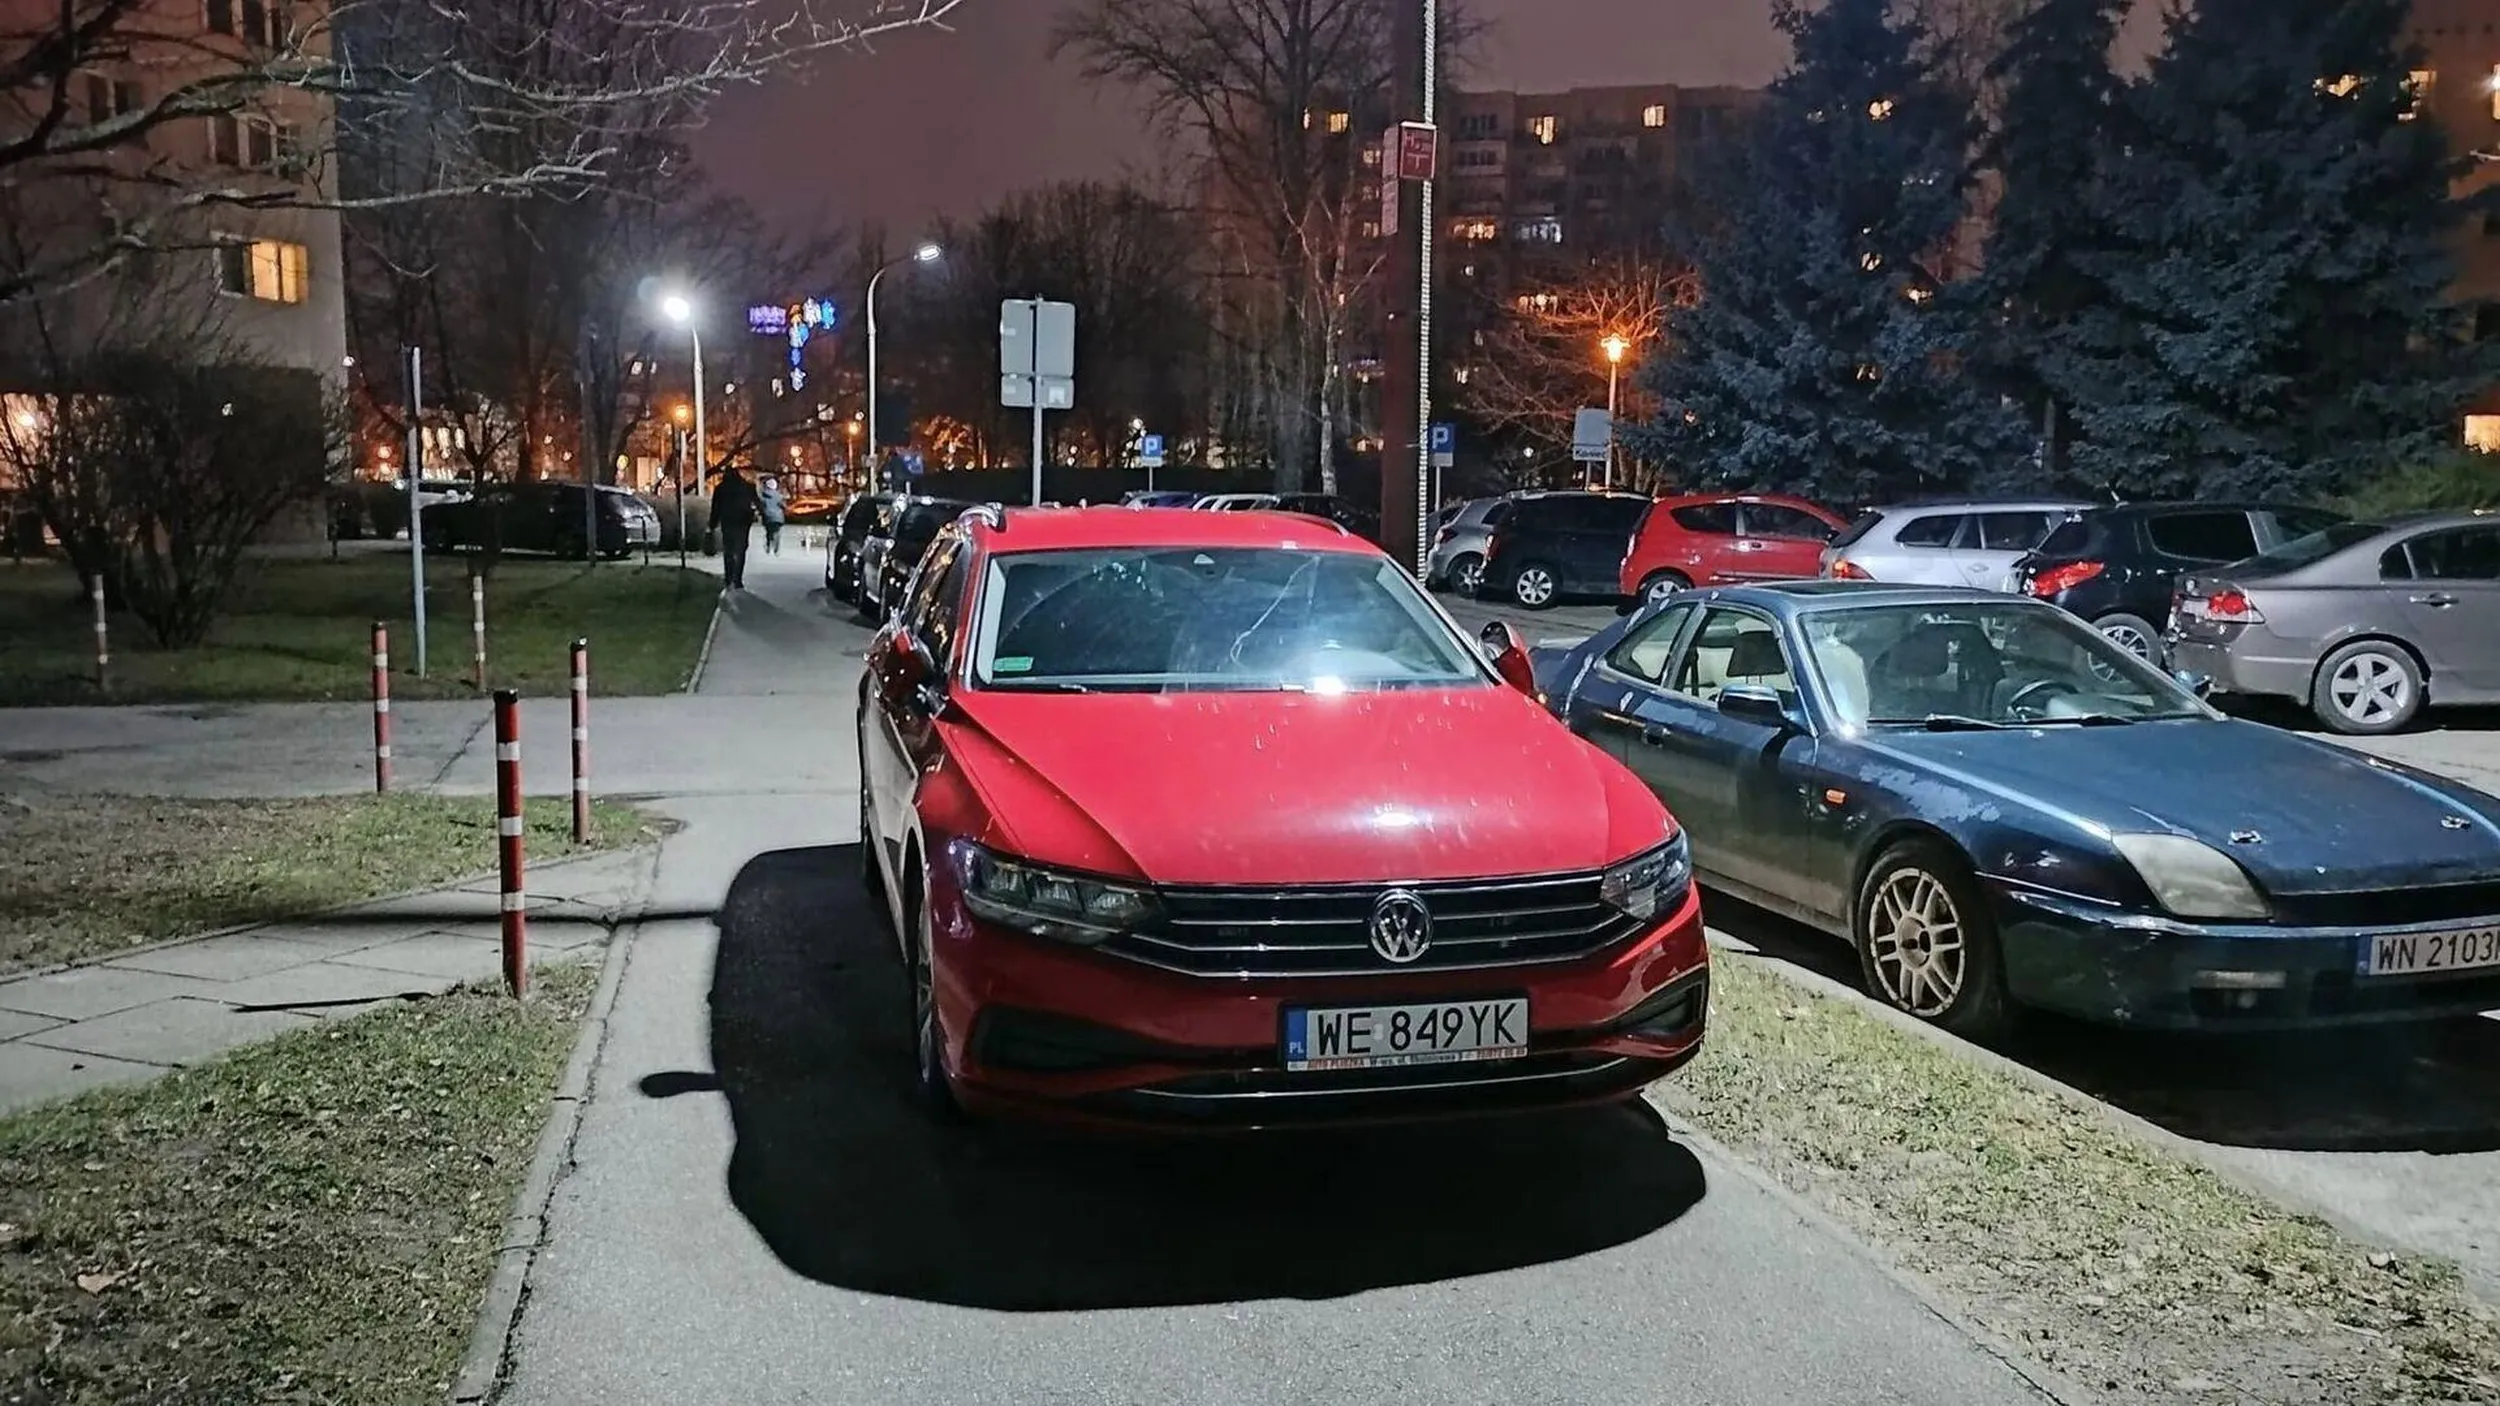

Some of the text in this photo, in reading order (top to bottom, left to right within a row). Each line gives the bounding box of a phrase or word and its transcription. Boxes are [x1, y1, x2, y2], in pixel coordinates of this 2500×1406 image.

[1145, 437, 1158, 455] P
[1432, 426, 1449, 449] P
[2378, 937, 2417, 970] WN
[1317, 1003, 1516, 1056] WE 849YK
[1289, 1042, 1304, 1054] PL
